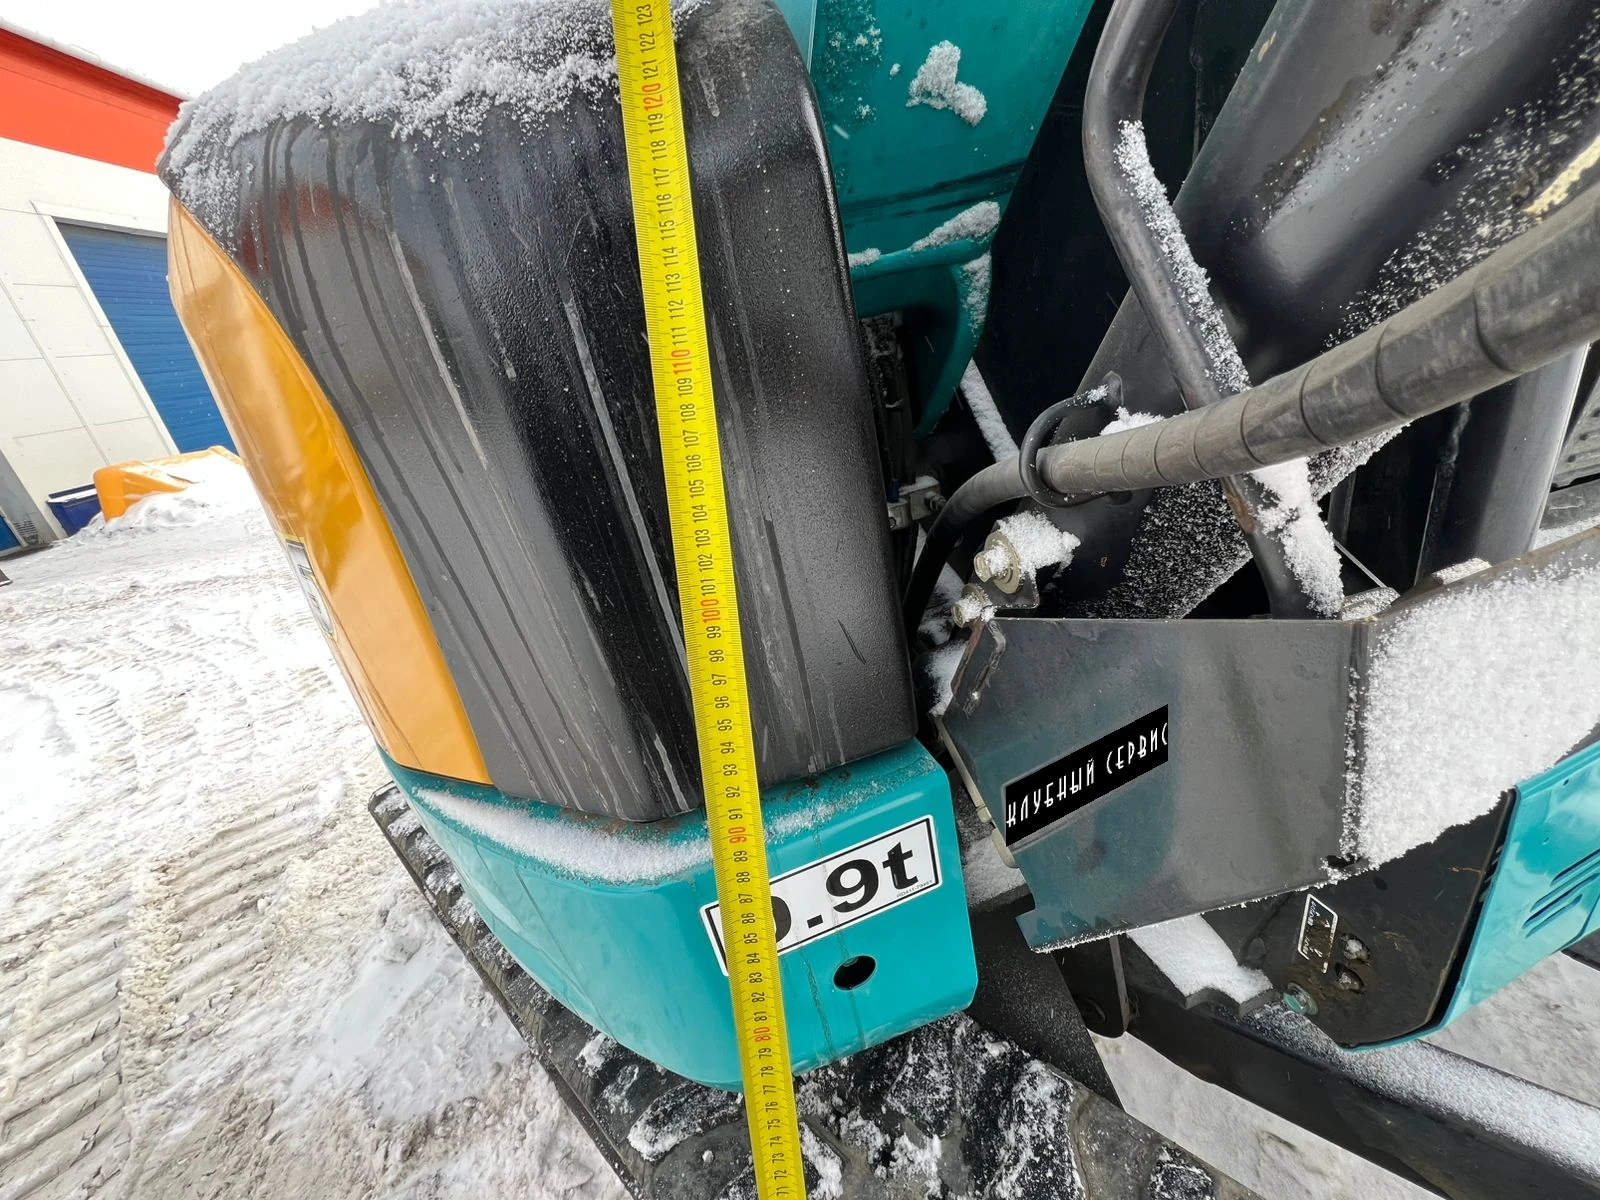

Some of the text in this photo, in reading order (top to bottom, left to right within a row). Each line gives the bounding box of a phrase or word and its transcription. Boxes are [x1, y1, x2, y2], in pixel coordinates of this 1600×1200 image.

[636, 4, 789, 1196] 71 72 73 74 75 76 77 78 79 80 81 82 83 84 85 86 87 88 89 90 91 92 93 94 95 96 97 98 99 100 101 102 103 104 105 106 107 108 109 110 111 112 113 114 115 116 117 118 119 120 121 122 123
